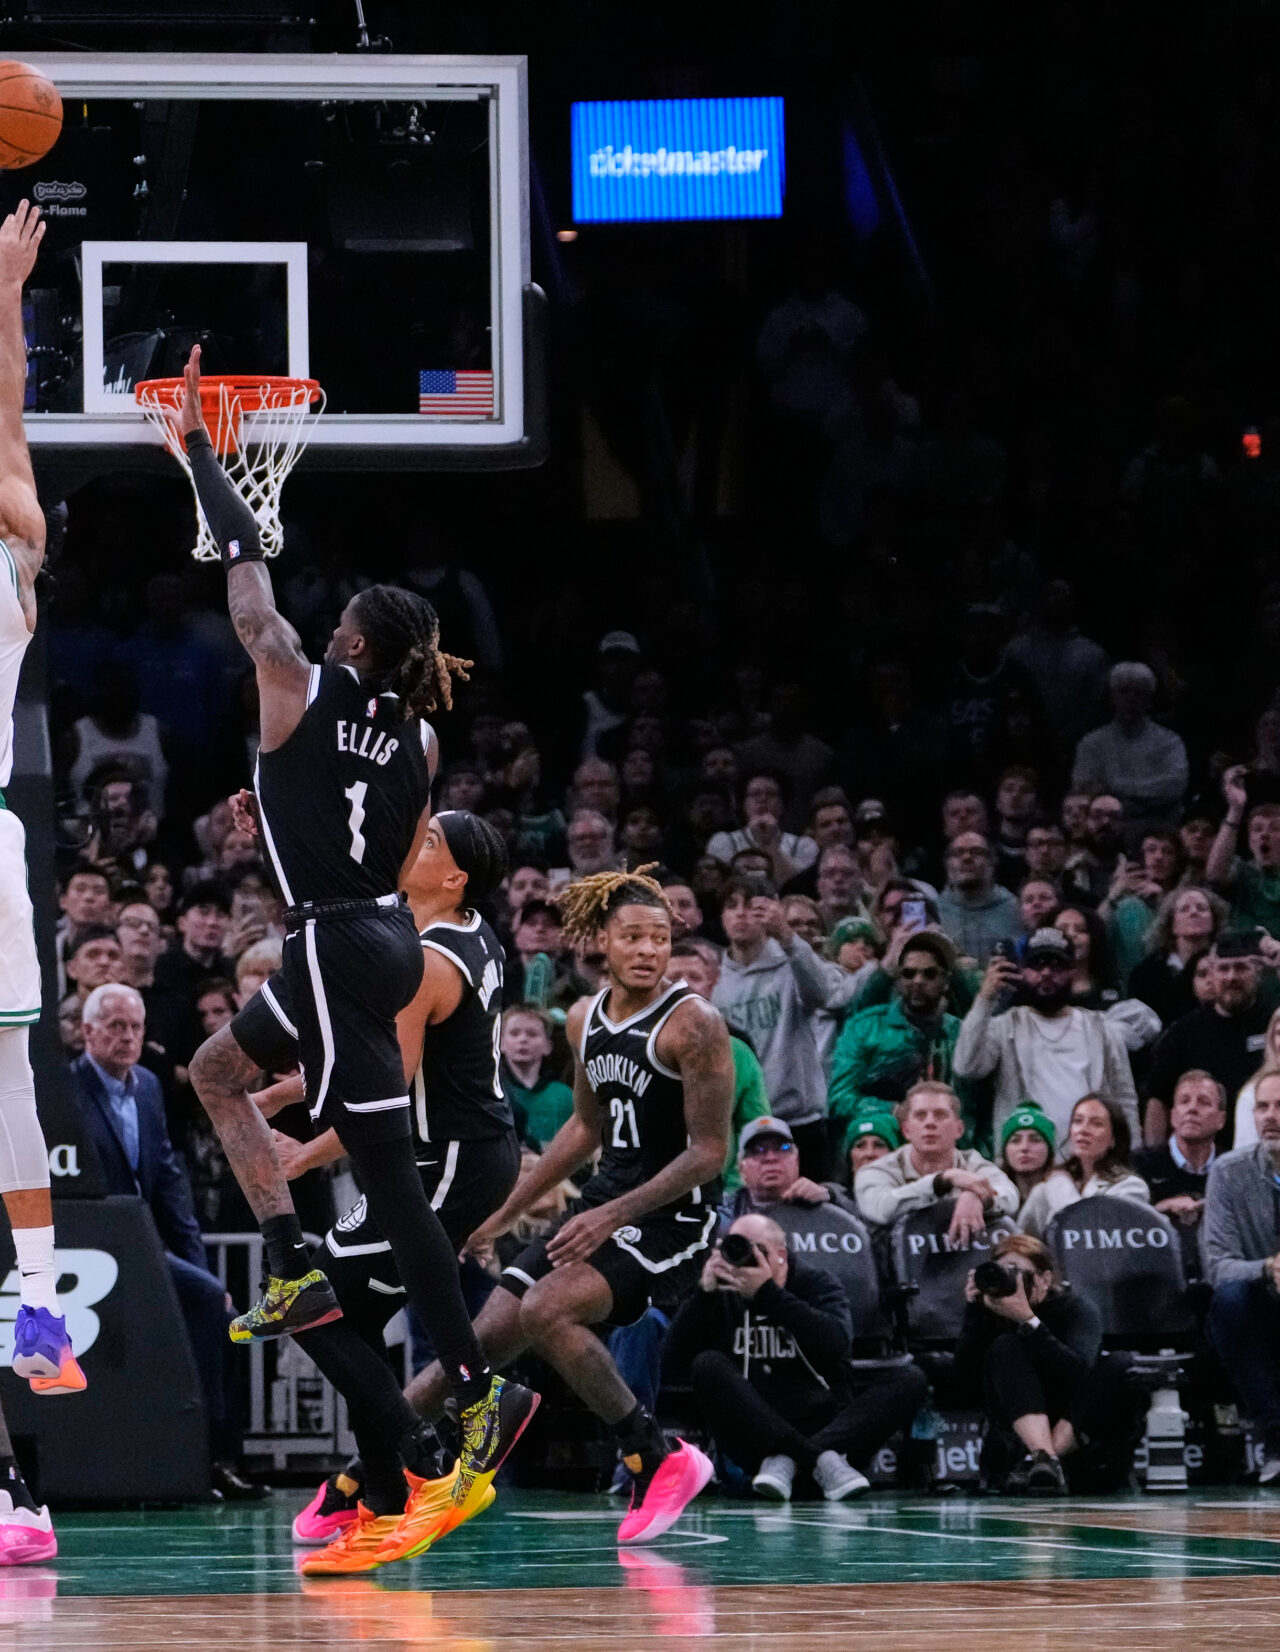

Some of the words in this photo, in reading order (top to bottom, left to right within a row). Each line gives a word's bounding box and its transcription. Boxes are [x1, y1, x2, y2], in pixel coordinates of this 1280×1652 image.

[337, 720, 399, 766] ELLIS
[345, 780, 368, 864] 1
[610, 1097, 641, 1148] 21
[791, 1231, 863, 1254] MCO
[1062, 1227, 1169, 1250] PIMCO
